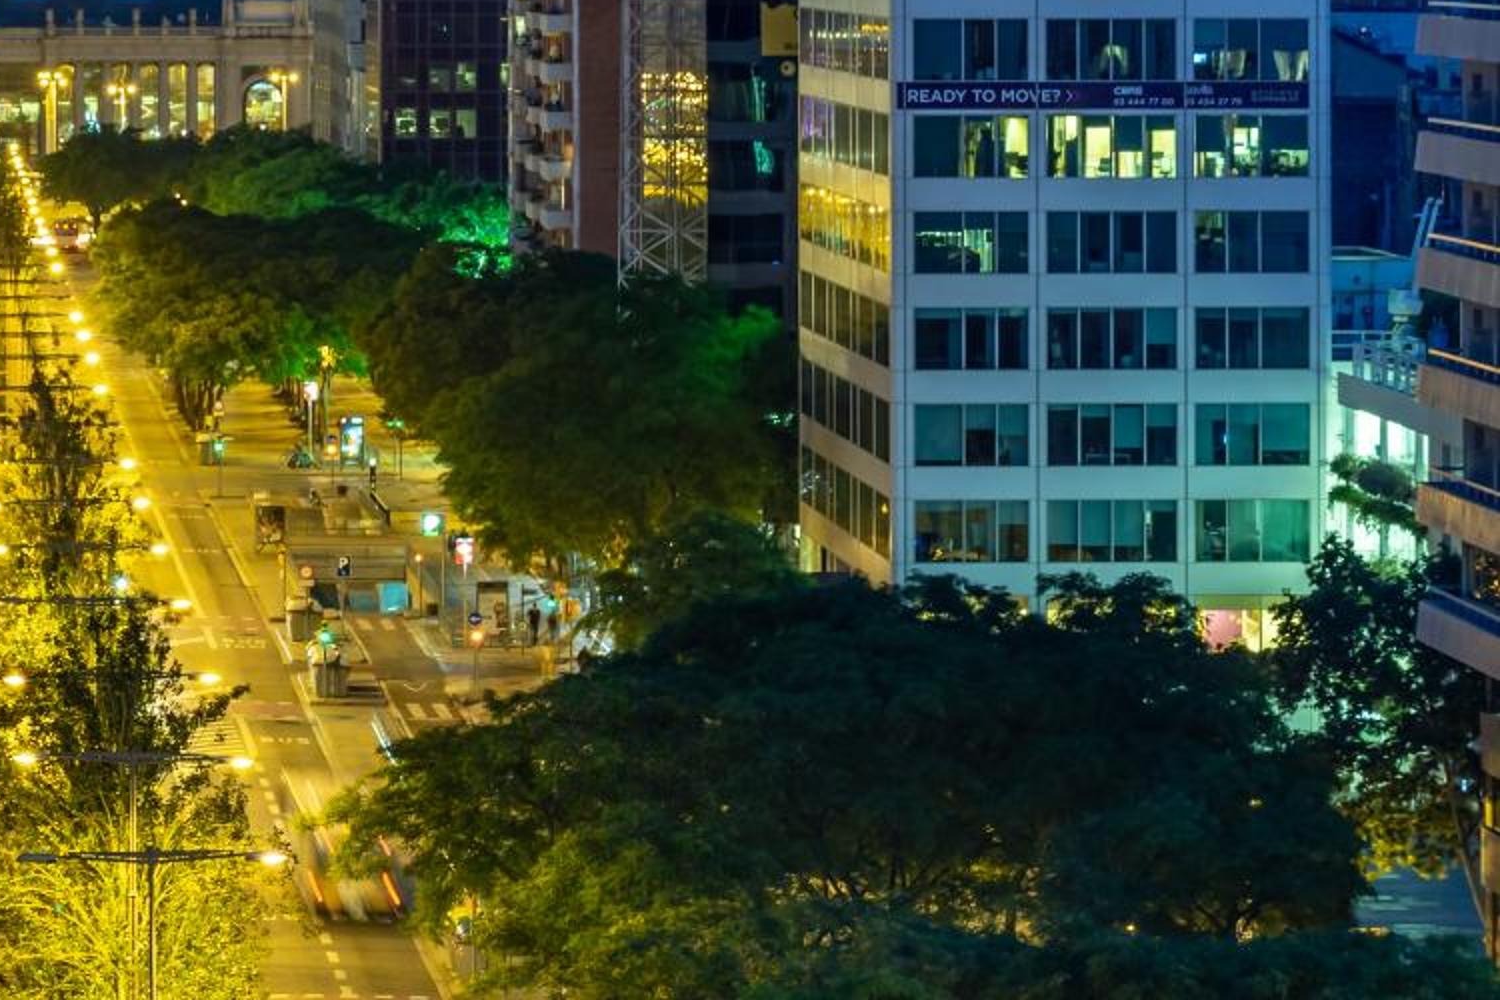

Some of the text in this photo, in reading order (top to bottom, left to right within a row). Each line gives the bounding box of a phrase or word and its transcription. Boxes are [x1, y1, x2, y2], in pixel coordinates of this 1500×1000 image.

[907, 89, 1061, 103] READY TO MOVE?
